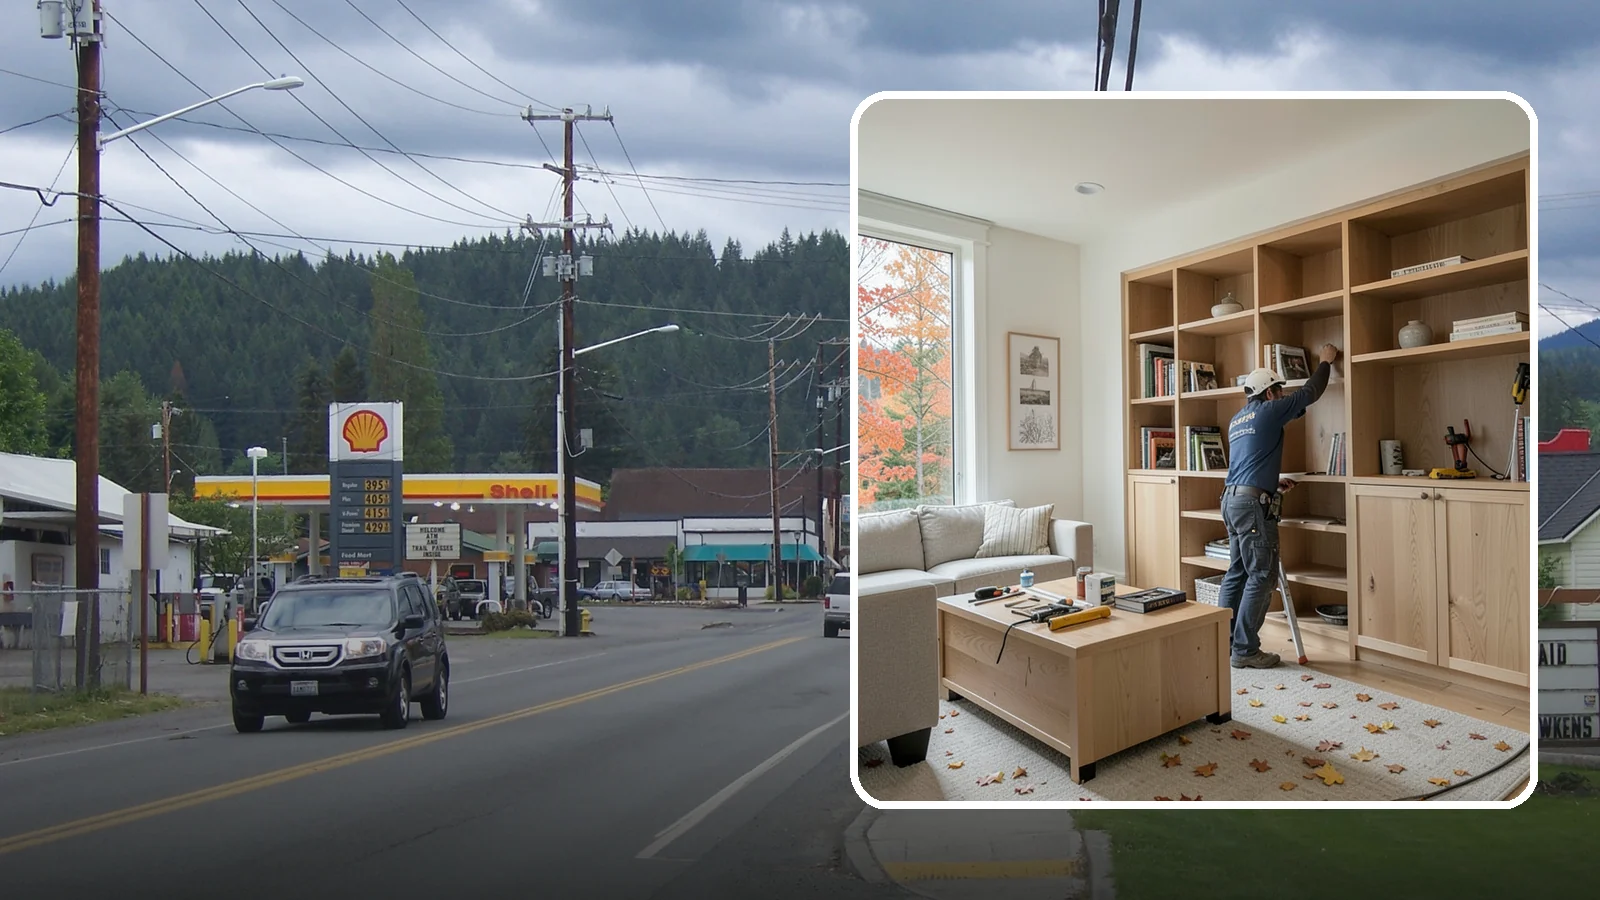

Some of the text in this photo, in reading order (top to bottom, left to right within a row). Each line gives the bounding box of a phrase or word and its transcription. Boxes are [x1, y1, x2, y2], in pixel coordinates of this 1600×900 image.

[365, 480, 384, 490] 395
[490, 484, 547, 499] Shell
[365, 494, 384, 504] 405
[365, 508, 384, 518] 415
[365, 522, 384, 532] 429
[1538, 643, 1566, 665] AID
